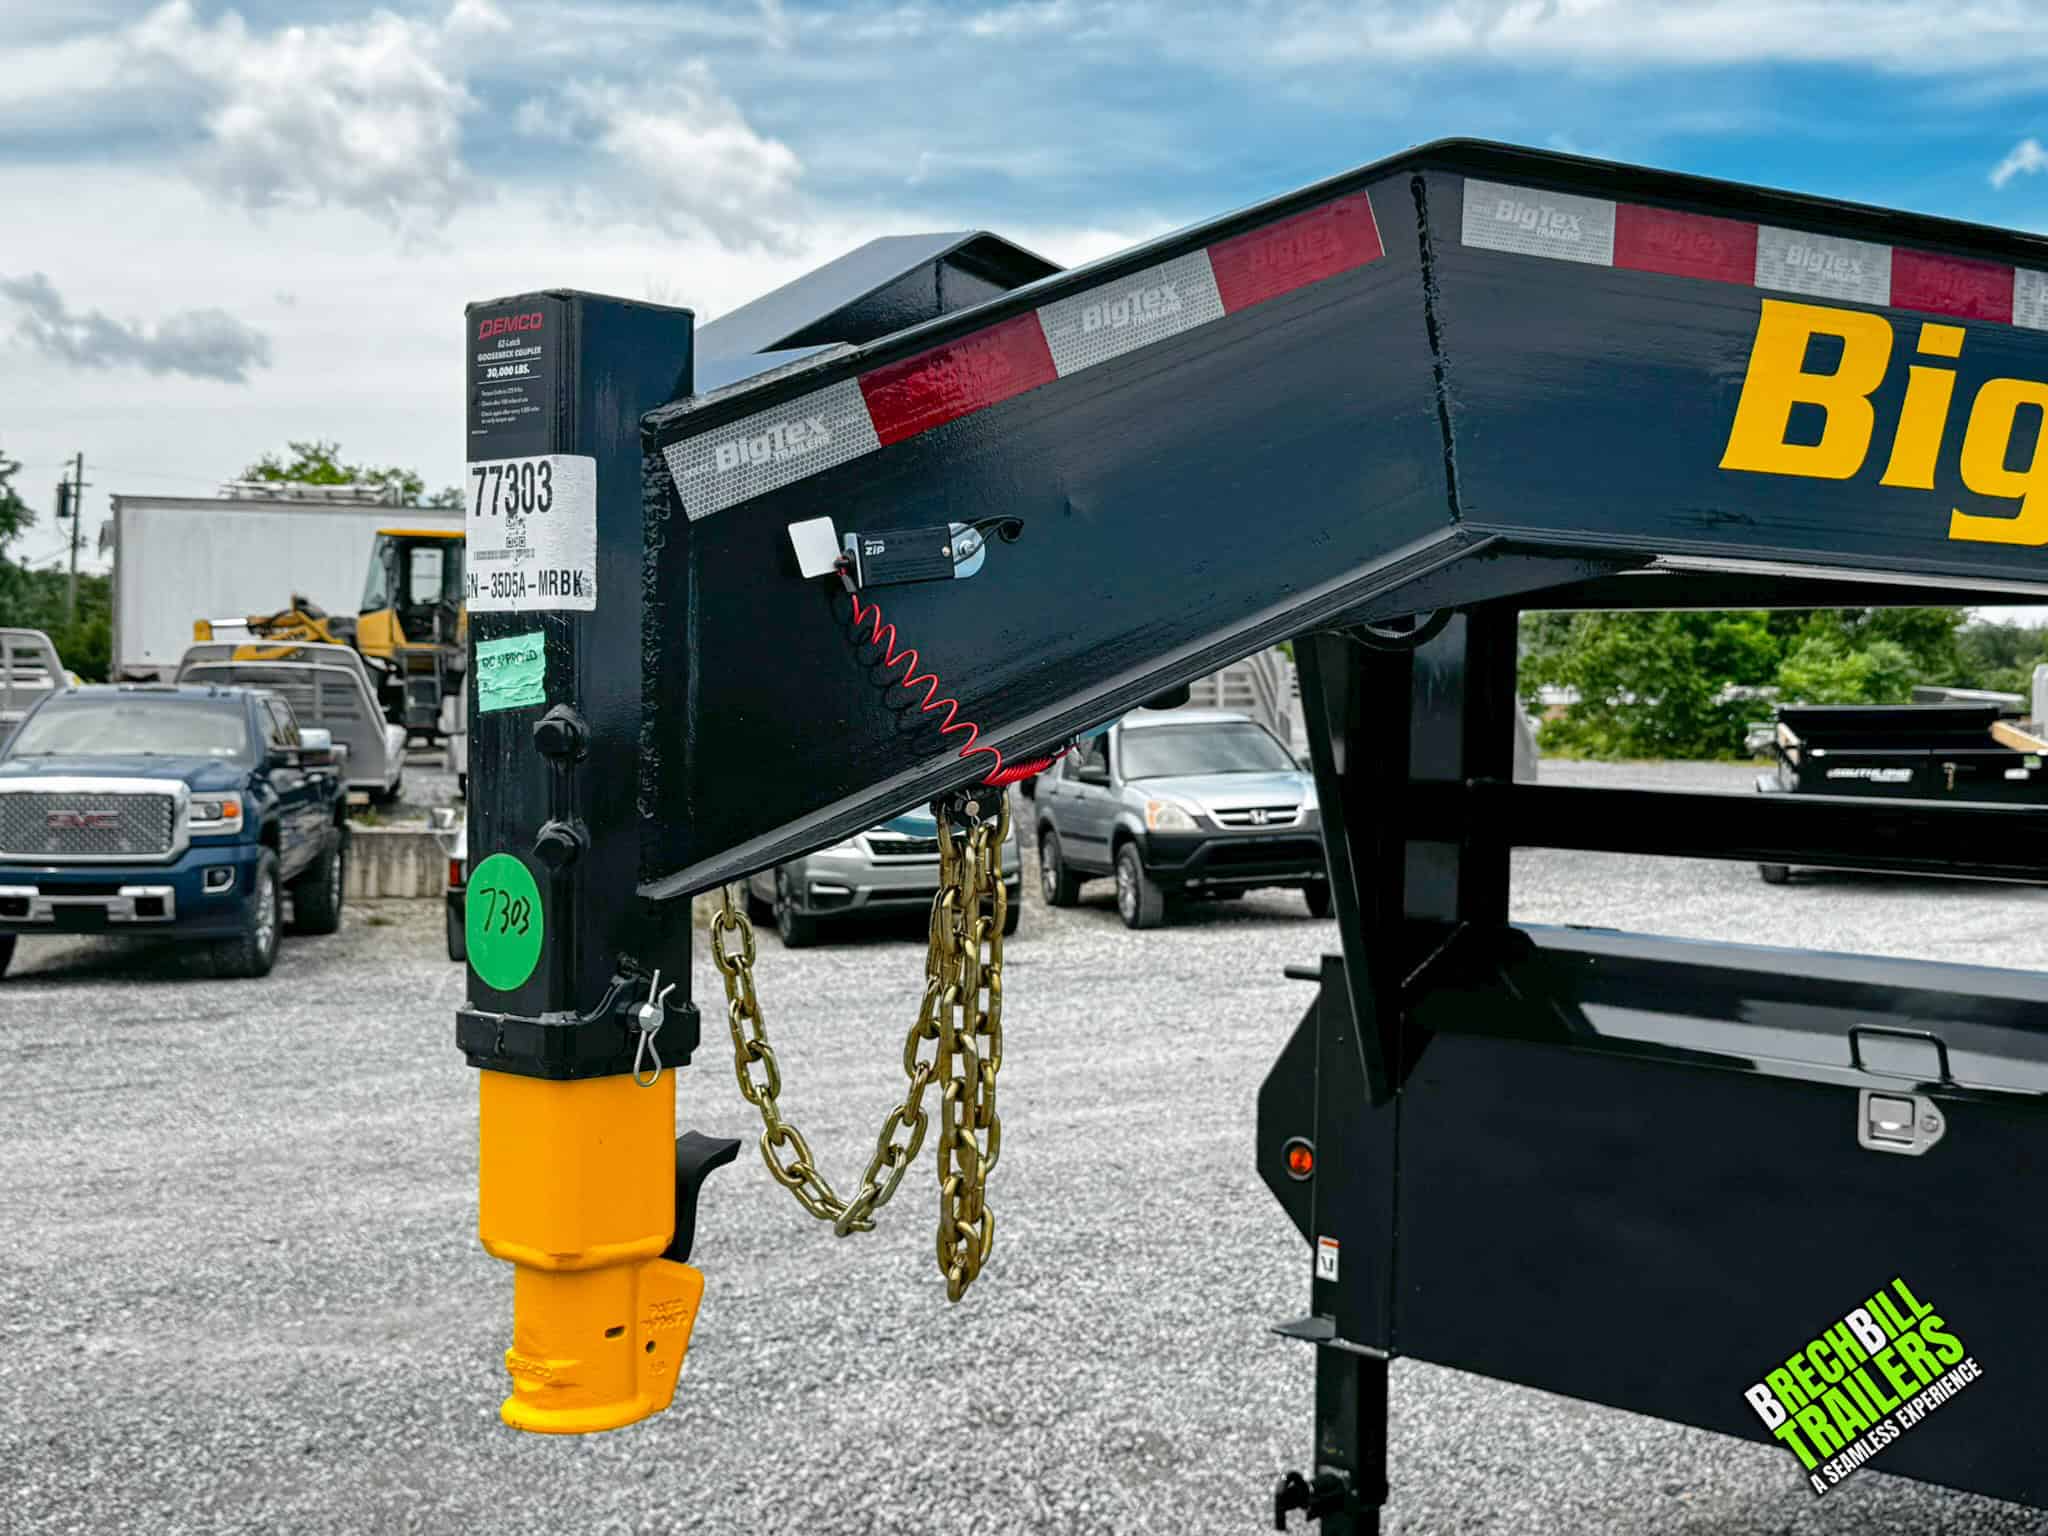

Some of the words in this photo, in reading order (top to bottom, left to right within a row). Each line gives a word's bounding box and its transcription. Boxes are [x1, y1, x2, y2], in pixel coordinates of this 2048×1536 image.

[1495, 199, 1583, 231] BigTex
[479, 312, 544, 341] DEMCO
[1081, 281, 1181, 335] BigTex
[486, 365, 514, 379] 30,000
[716, 416, 826, 471] BigTex
[1718, 298, 2048, 547] Big
[472, 460, 552, 517] 77303
[480, 887, 530, 936] 7303
